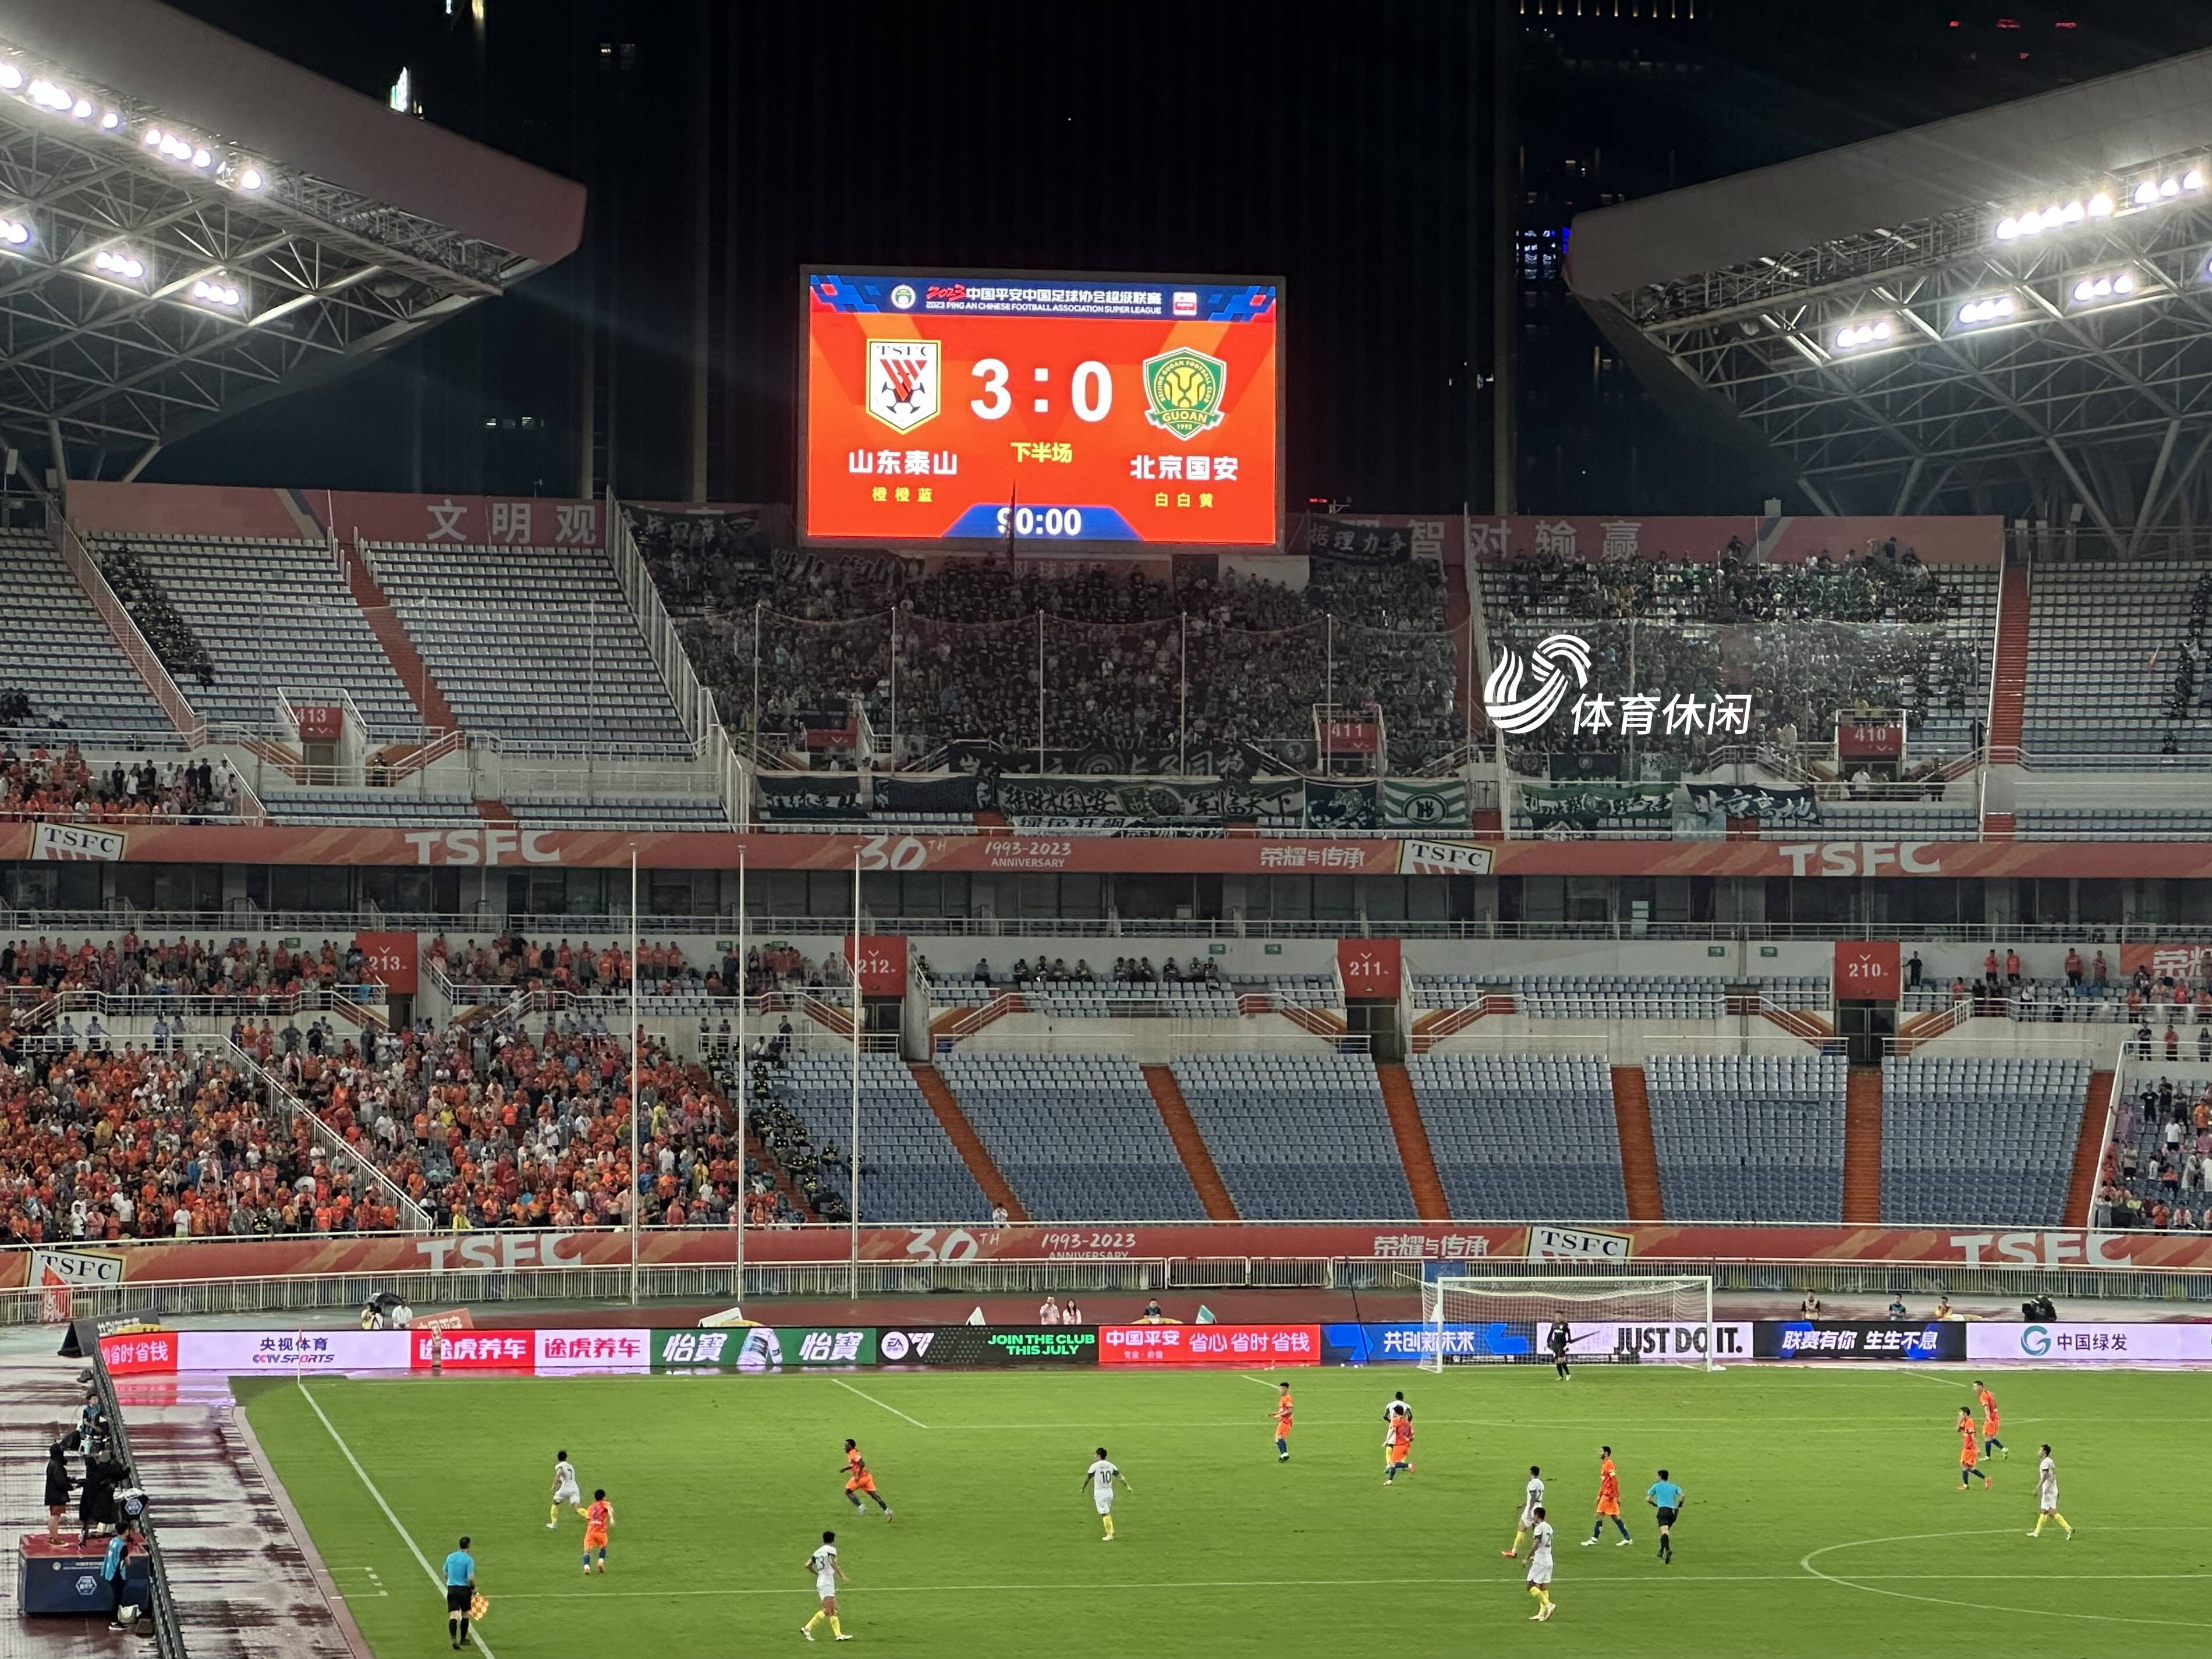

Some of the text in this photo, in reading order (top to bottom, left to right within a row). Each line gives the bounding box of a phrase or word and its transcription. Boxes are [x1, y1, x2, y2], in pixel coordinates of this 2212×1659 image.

[1012, 303, 1051, 311] FOOTBALL
[1052, 304, 1104, 313] ASSOCIATION
[1130, 306, 1161, 314] LEAGUE
[1162, 410, 1208, 423] GUOAN
[1011, 441, 1073, 463] 下半场
[849, 449, 958, 475] 山东泰山
[1130, 456, 1239, 481] 北京国安
[1154, 492, 1214, 508] 白白黄
[1332, 723, 1363, 737] 411
[1855, 728, 1887, 742] 410
[44, 827, 116, 853] TSFC
[405, 830, 559, 865] TSFC
[984, 841, 1072, 856] 1993-2023
[991, 857, 1066, 868] ANNIVERSARY
[1260, 846, 1366, 868] 荣耀与传承
[1412, 843, 1483, 867] TSFC
[1779, 842, 1941, 877] TSFC
[369, 956, 400, 971] 213
[859, 959, 889, 974] 212
[1350, 961, 1381, 976] 211
[1849, 963, 1882, 978] 210
[1041, 1232, 1136, 1249] 1993-2023
[1373, 1233, 1490, 1257] 荣耀与传承
[1541, 1230, 1618, 1256] TSFC
[417, 1232, 582, 1275] TSFC
[1950, 1232, 2133, 1270] TSFC
[40, 1255, 112, 1280] TSFC
[260, 1337, 328, 1351] 央视体育
[662, 1332, 728, 1362] 怡寶
[799, 1331, 864, 1361] 怡寶
[887, 1338, 903, 1347] EA
[988, 1334, 1096, 1345] JOIN THE CLUB
[1105, 1330, 1180, 1346] 中国平安
[1383, 1331, 1475, 1352] 共创新未来
[1614, 1327, 1743, 1354] JUST DO IT.
[1782, 1330, 1938, 1350] 联赛有你 生生不息
[2056, 1333, 2128, 1352] 中国绿发
[544, 1337, 641, 1360] 途虎养车
[1006, 1345, 1079, 1355] THIS JULY
[1101, 1470, 1111, 1484] 10
